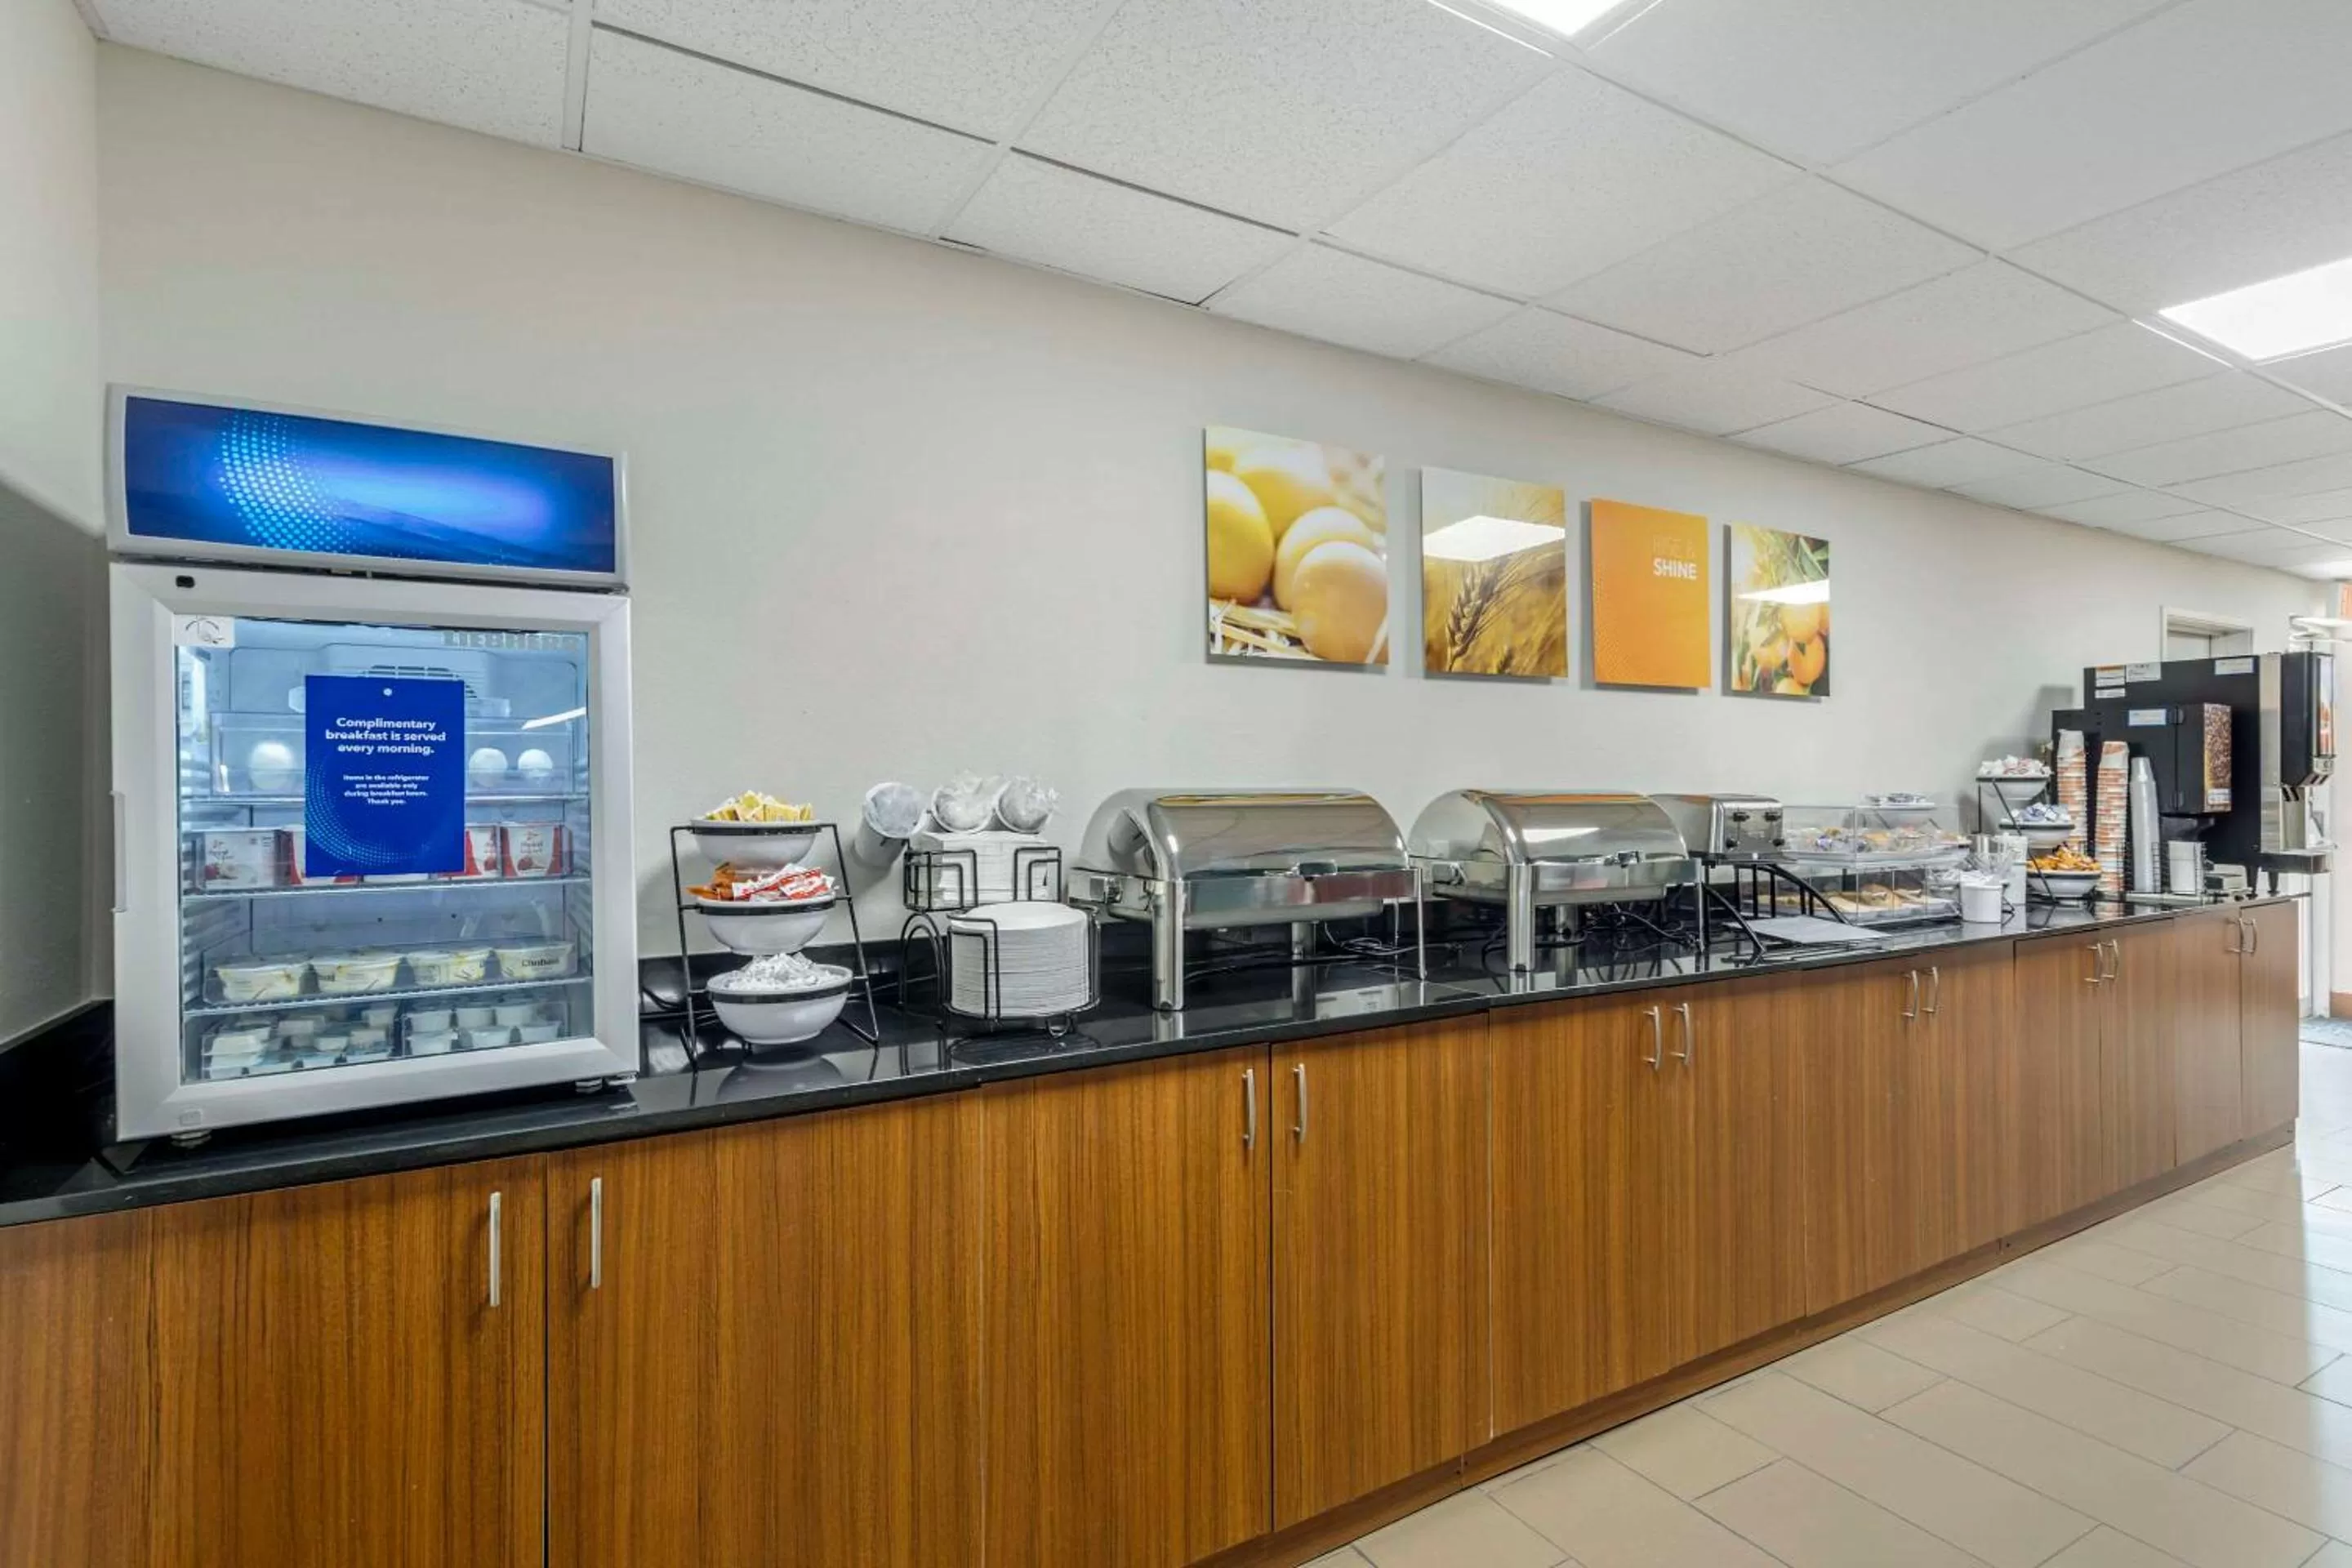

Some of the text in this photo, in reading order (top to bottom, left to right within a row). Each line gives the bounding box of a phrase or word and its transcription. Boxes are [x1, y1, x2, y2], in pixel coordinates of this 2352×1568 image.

[1653, 558, 1697, 579] SHINE
[336, 717, 437, 731] Complimentary
[325, 729, 446, 742] breakfast is served
[337, 743, 435, 756] every morning.
